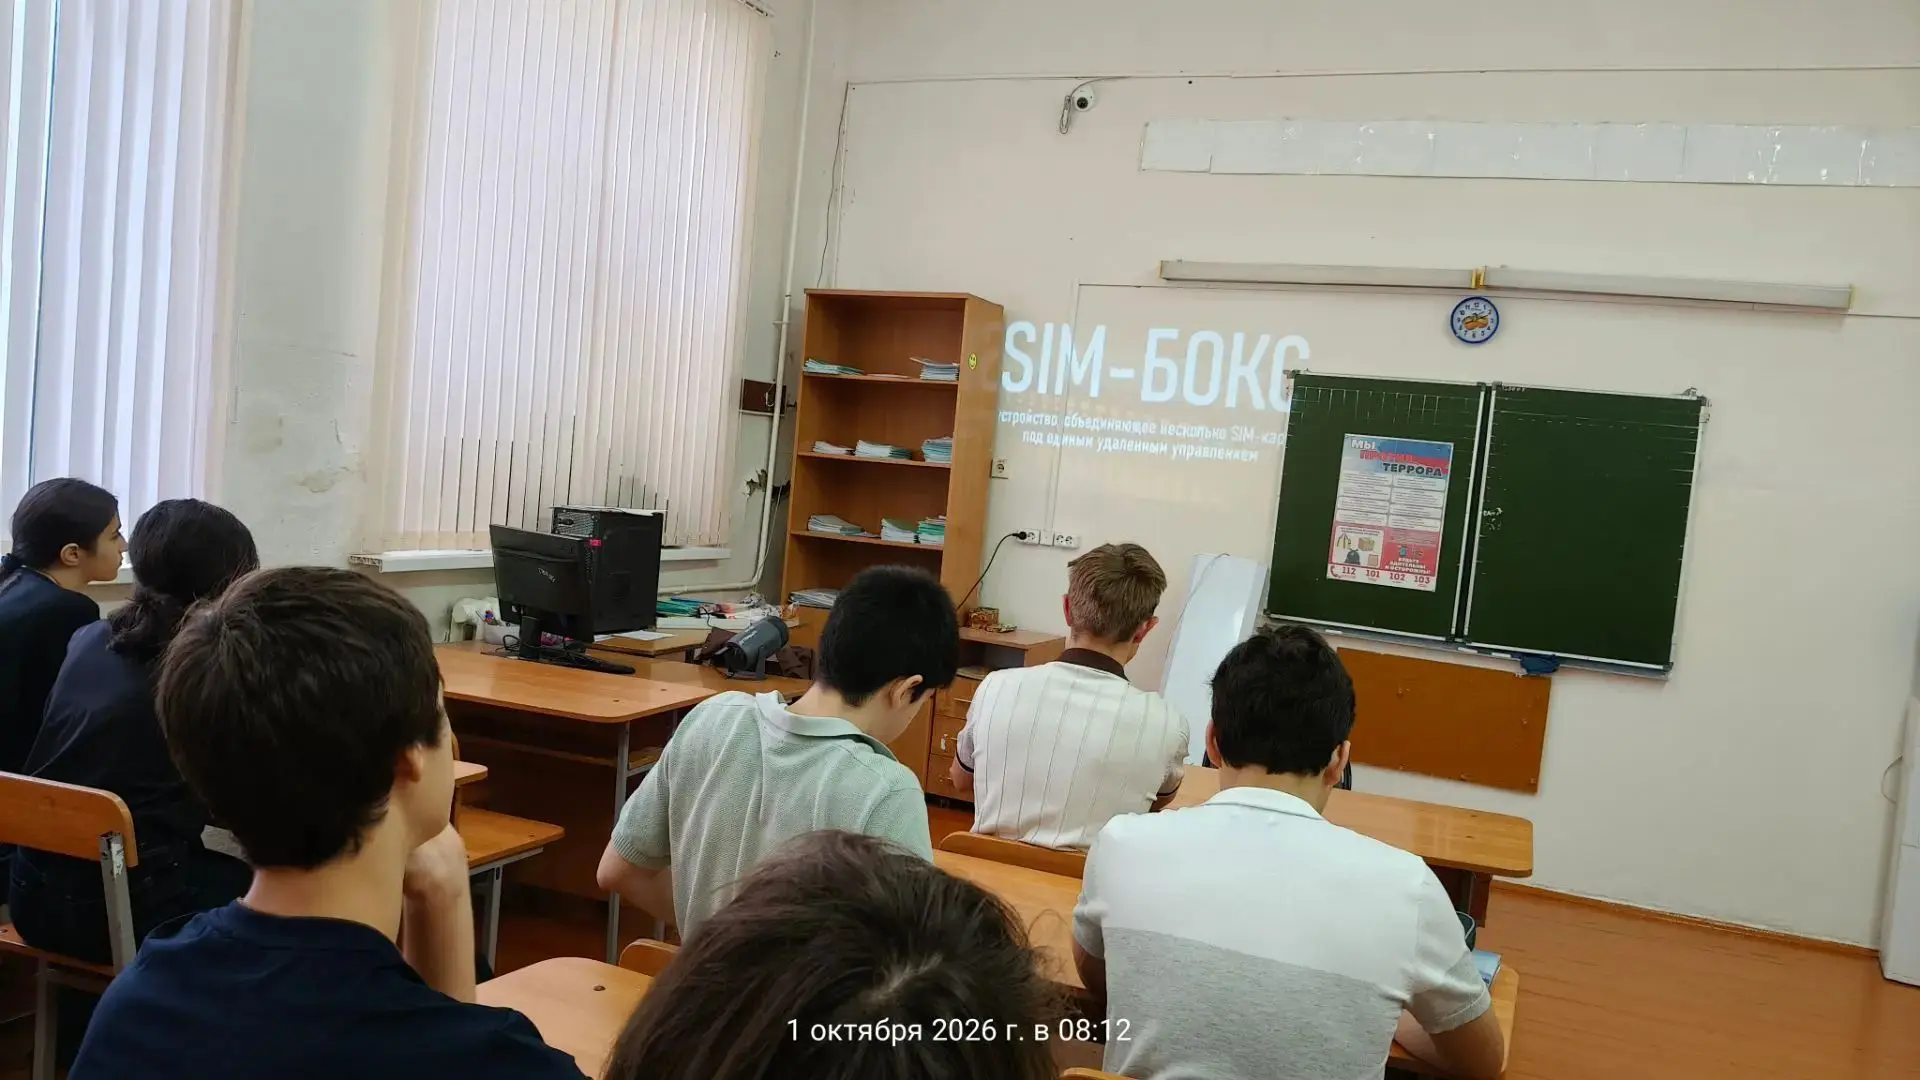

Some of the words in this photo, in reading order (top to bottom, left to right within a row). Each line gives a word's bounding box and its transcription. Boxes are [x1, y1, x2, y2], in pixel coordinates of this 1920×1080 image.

[1002, 321, 1310, 413] SIM-БОКС
[999, 409, 1059, 428] стройство,
[1064, 412, 1156, 435] объединяющее
[1159, 419, 1227, 440] несколько
[1230, 424, 1288, 446] SIM-кар
[1022, 429, 1044, 444] под
[1046, 432, 1094, 449] единым
[1171, 444, 1259, 463] управлением
[1383, 462, 1442, 477] ТЕРРОРА
[1342, 566, 1357, 576] 112
[1366, 569, 1380, 579] 101
[1390, 572, 1406, 581] 102
[1414, 575, 1431, 584] 103
